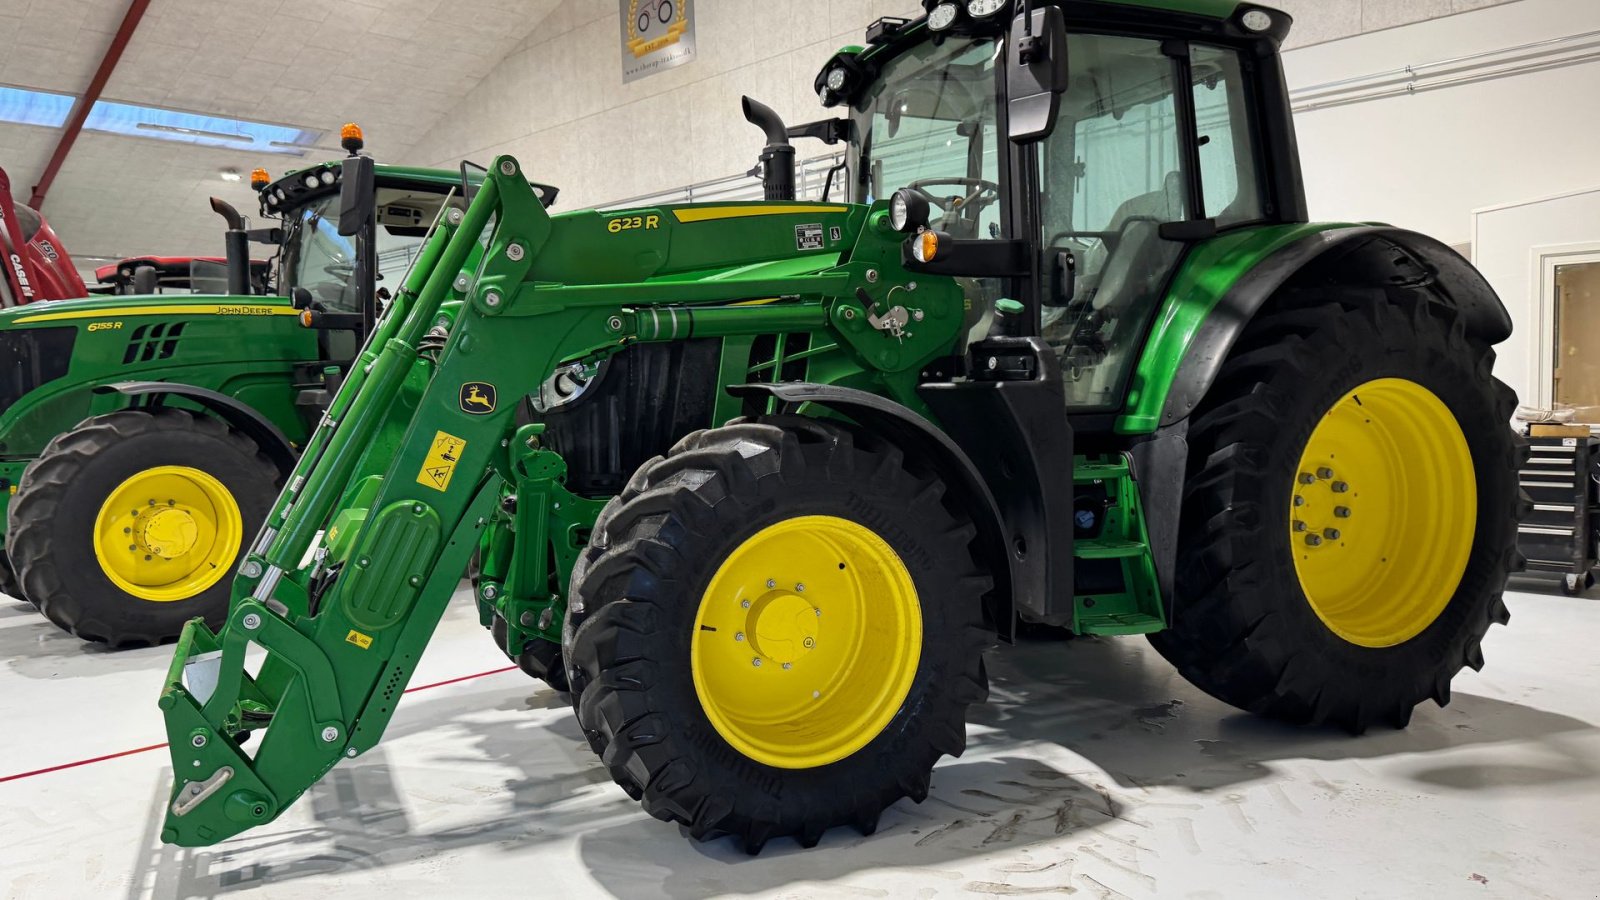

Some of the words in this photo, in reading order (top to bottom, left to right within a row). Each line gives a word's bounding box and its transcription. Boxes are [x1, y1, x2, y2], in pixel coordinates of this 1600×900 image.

[607, 216, 642, 233] 623
[645, 215, 659, 229] R
[40, 239, 59, 260] 150
[10, 254, 29, 286] CASE
[215, 306, 242, 315] JOHN
[242, 305, 273, 315] DEERE
